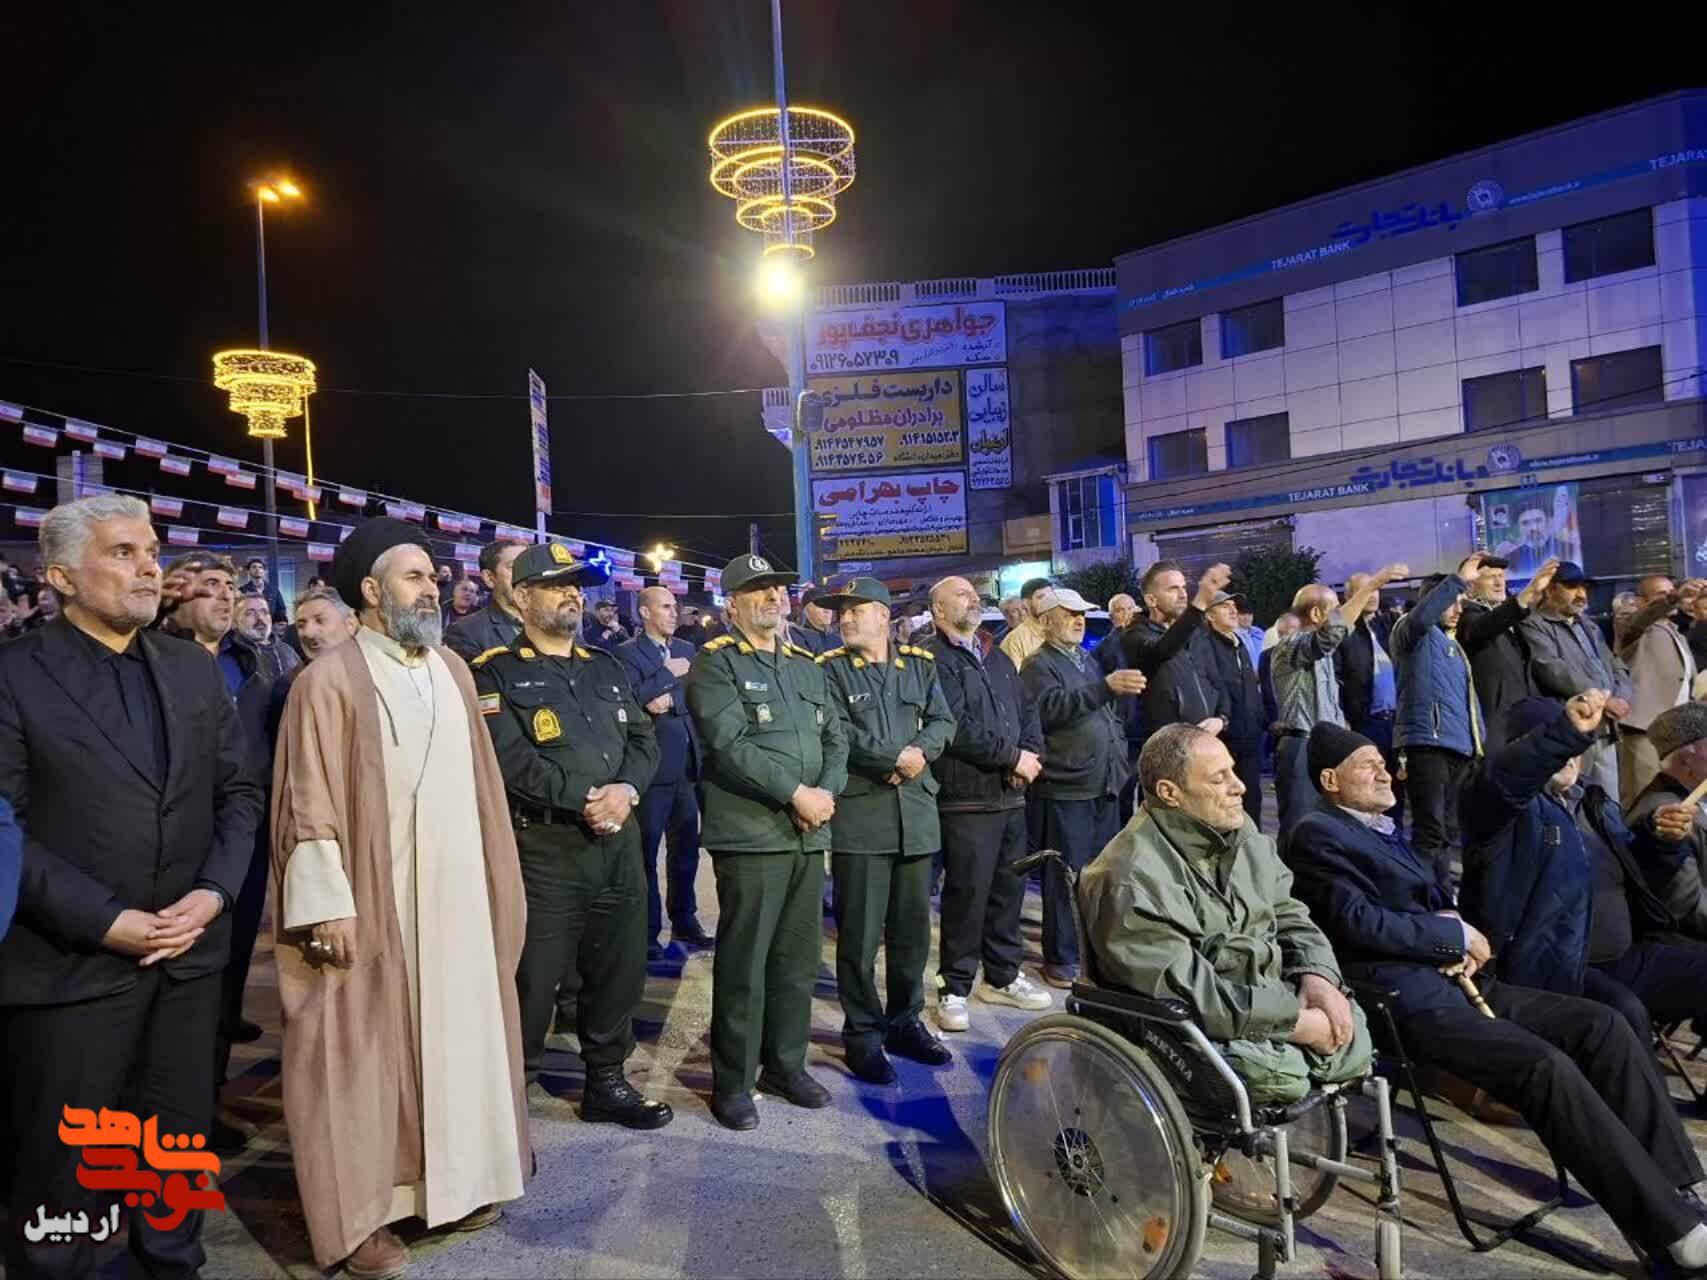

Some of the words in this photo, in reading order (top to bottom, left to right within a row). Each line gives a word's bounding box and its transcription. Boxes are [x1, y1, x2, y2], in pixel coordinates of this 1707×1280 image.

[1648, 150, 1707, 171] TEJARA
[1271, 248, 1318, 272] TEJARAT
[1319, 240, 1350, 257] BANK
[901, 307, 998, 344] جواهری
[882, 377, 953, 403] داربست
[823, 410, 894, 433] مظلومی
[893, 408, 944, 427] برادران
[1350, 456, 1437, 489] تجارت
[1409, 457, 1489, 488] بانک
[819, 481, 902, 507] بهرامی
[907, 476, 960, 504] چاپ
[1288, 486, 1336, 503] TEJARAT
[1337, 482, 1369, 496] BANK
